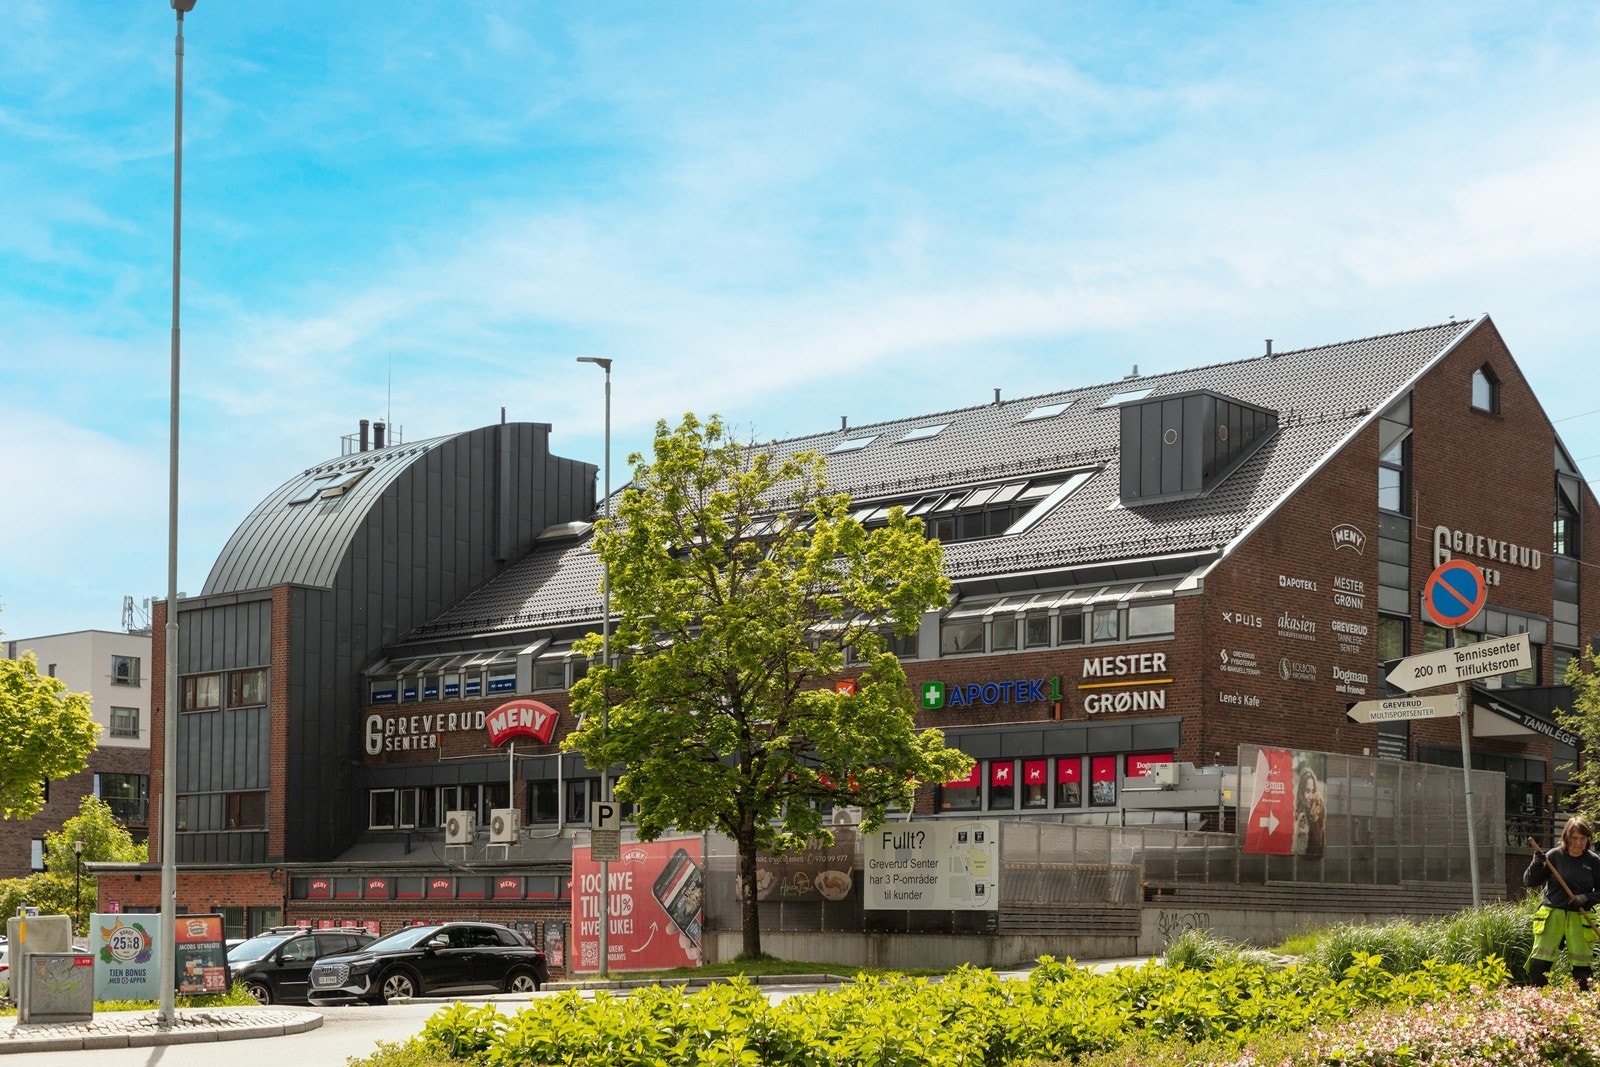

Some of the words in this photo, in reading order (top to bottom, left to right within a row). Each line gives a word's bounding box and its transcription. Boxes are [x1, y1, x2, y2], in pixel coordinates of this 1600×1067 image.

[1335, 529, 1362, 547] MENY
[1453, 530, 1541, 570] GREVERUD
[1333, 576, 1364, 593] MESTER
[1333, 594, 1364, 609] GRØNN
[1277, 611, 1316, 633] akasien
[1331, 620, 1368, 636] GREVERUD
[1232, 650, 1256, 660] GREVERUD
[1340, 643, 1360, 654] SENTER
[1453, 642, 1521, 663] Tennissenter
[1082, 652, 1167, 678] MESTER
[1414, 665, 1433, 679] 200
[1437, 664, 1447, 674] m
[1455, 657, 1519, 678] Tilfluktsrom
[1332, 665, 1369, 684] Dogman
[949, 678, 1044, 707] APOTEK
[1047, 676, 1063, 701] 1
[1335, 684, 1347, 694] and
[1347, 685, 1366, 696] friends
[1083, 690, 1166, 714] GRØNN
[1243, 694, 1260, 707] Kafe
[1382, 699, 1422, 709] GREVERUD
[1370, 708, 1435, 720] MULTISPORTSENTER
[386, 709, 487, 736] GREVERUD
[489, 707, 548, 737] MENY
[1523, 715, 1578, 747] TANNLEGE
[385, 732, 437, 751] SENTER
[598, 805, 614, 828] P
[881, 830, 926, 850] Fullt?
[623, 850, 645, 861] MENY
[814, 855, 827, 863] 970
[868, 858, 909, 871] Greverud
[909, 858, 939, 870] Senter
[312, 881, 327, 890] MENY
[369, 881, 385, 889] MENY
[433, 881, 449, 889] MENY
[499, 880, 516, 889] MENY
[607, 871, 633, 891] NYE
[869, 874, 884, 885] har
[885, 874, 891, 885] 3
[893, 874, 938, 886] P-områder
[884, 889, 892, 900] til
[893, 889, 923, 900] kunder
[609, 918, 634, 935] UKE!
[113, 936, 127, 950] 25
[132, 936, 140, 950] 8
[178, 943, 197, 951] JACOBS
[109, 968, 123, 977] TJEN
[125, 968, 147, 977] BONUS
[205, 975, 212, 987] 3
[218, 975, 225, 986] 2
